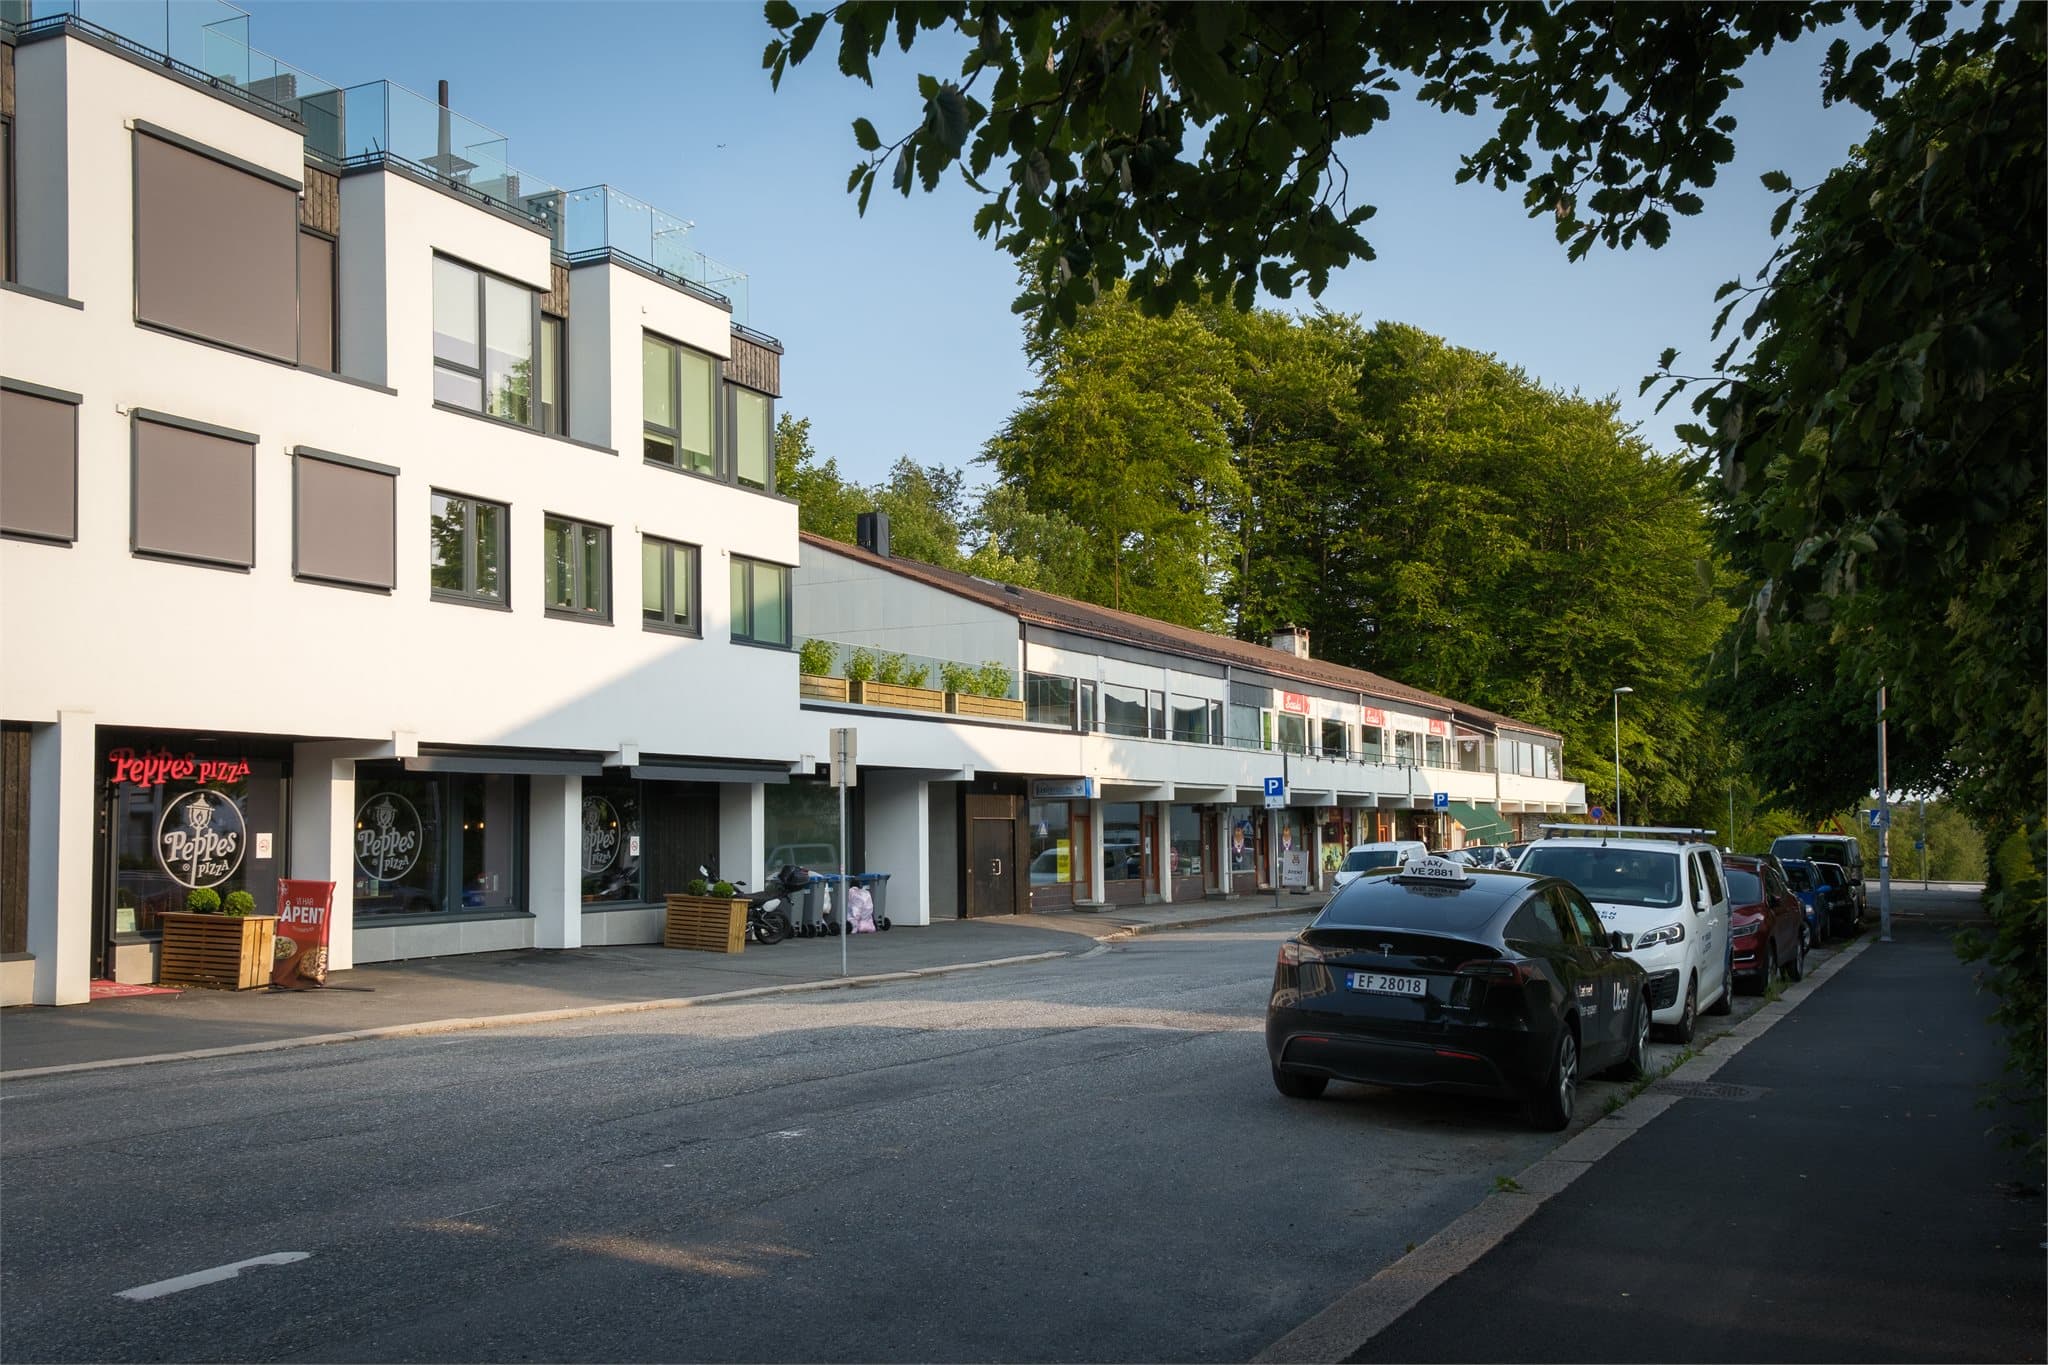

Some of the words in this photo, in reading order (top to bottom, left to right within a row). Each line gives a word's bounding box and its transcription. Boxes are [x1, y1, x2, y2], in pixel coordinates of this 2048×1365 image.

[109, 746, 196, 788] Peppes
[1269, 779, 1279, 794] P
[1437, 794, 1446, 806] P
[164, 827, 238, 862] Peppes
[357, 827, 416, 857] Peppes
[582, 826, 616, 852] eppes
[1411, 867, 1426, 876] VE
[1428, 868, 1453, 877] 2881
[1421, 860, 1444, 868] TAXI
[280, 899, 325, 924] ÅPENT
[1358, 974, 1374, 988] EF
[1379, 976, 1421, 993] 28018
[1612, 981, 1629, 1011] Uber
